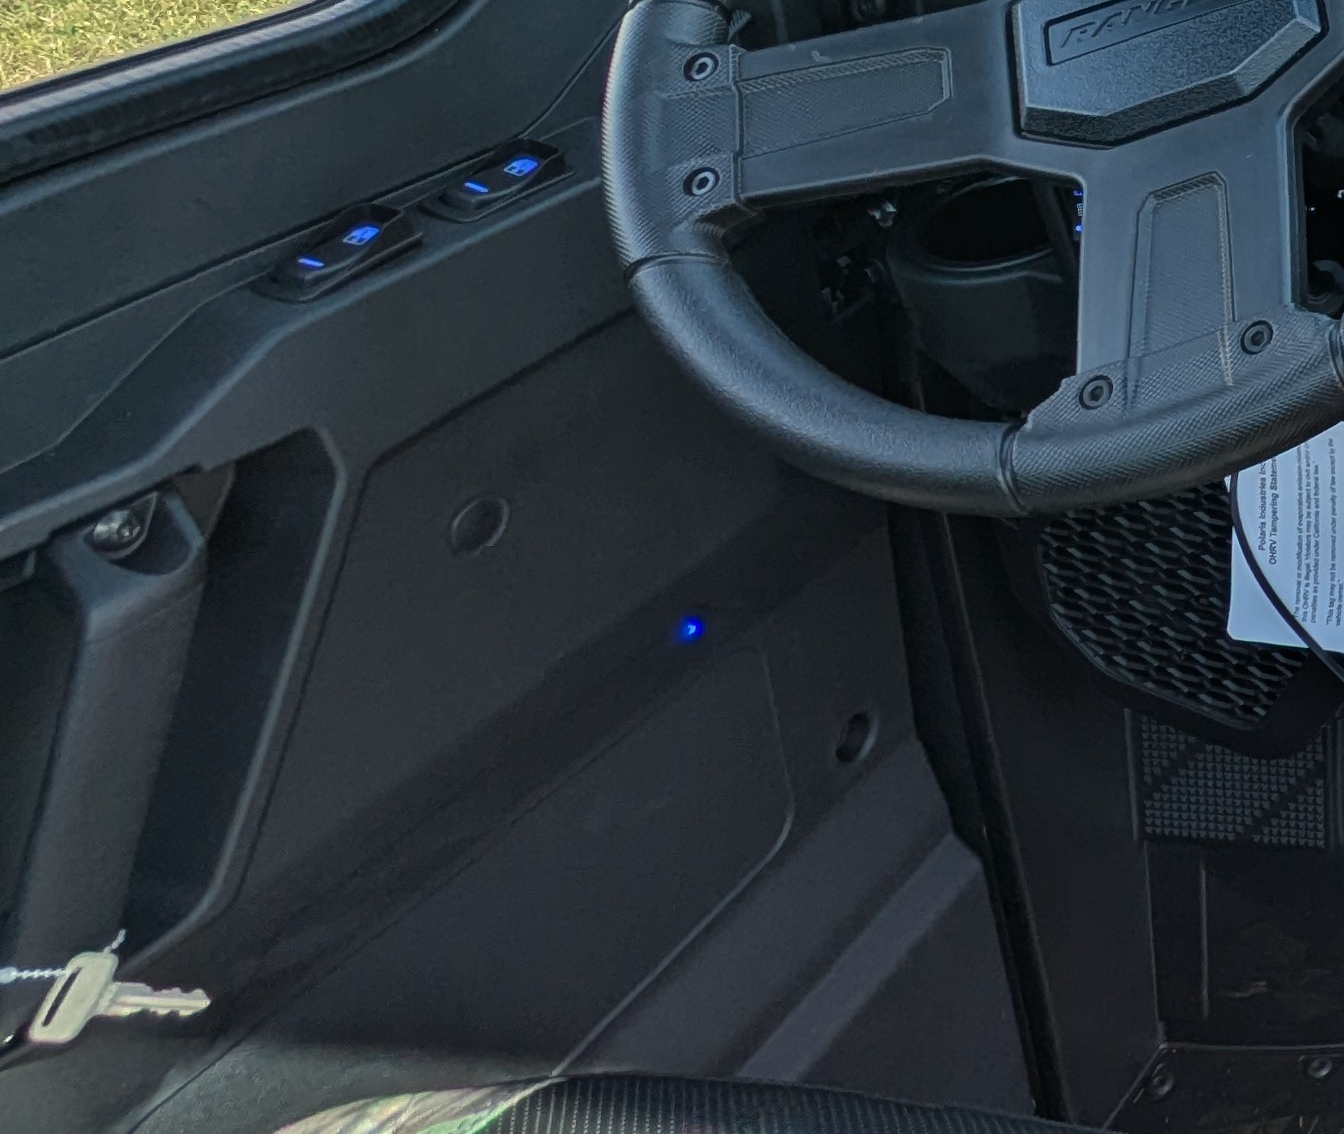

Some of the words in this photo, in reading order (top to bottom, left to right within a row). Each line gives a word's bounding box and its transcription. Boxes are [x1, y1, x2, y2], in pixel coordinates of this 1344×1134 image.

[1270, 493, 1279, 537] Tampering
[1258, 522, 1266, 550] Polaris
[1269, 540, 1277, 564] OHRV
[1310, 595, 1318, 623] penalties
